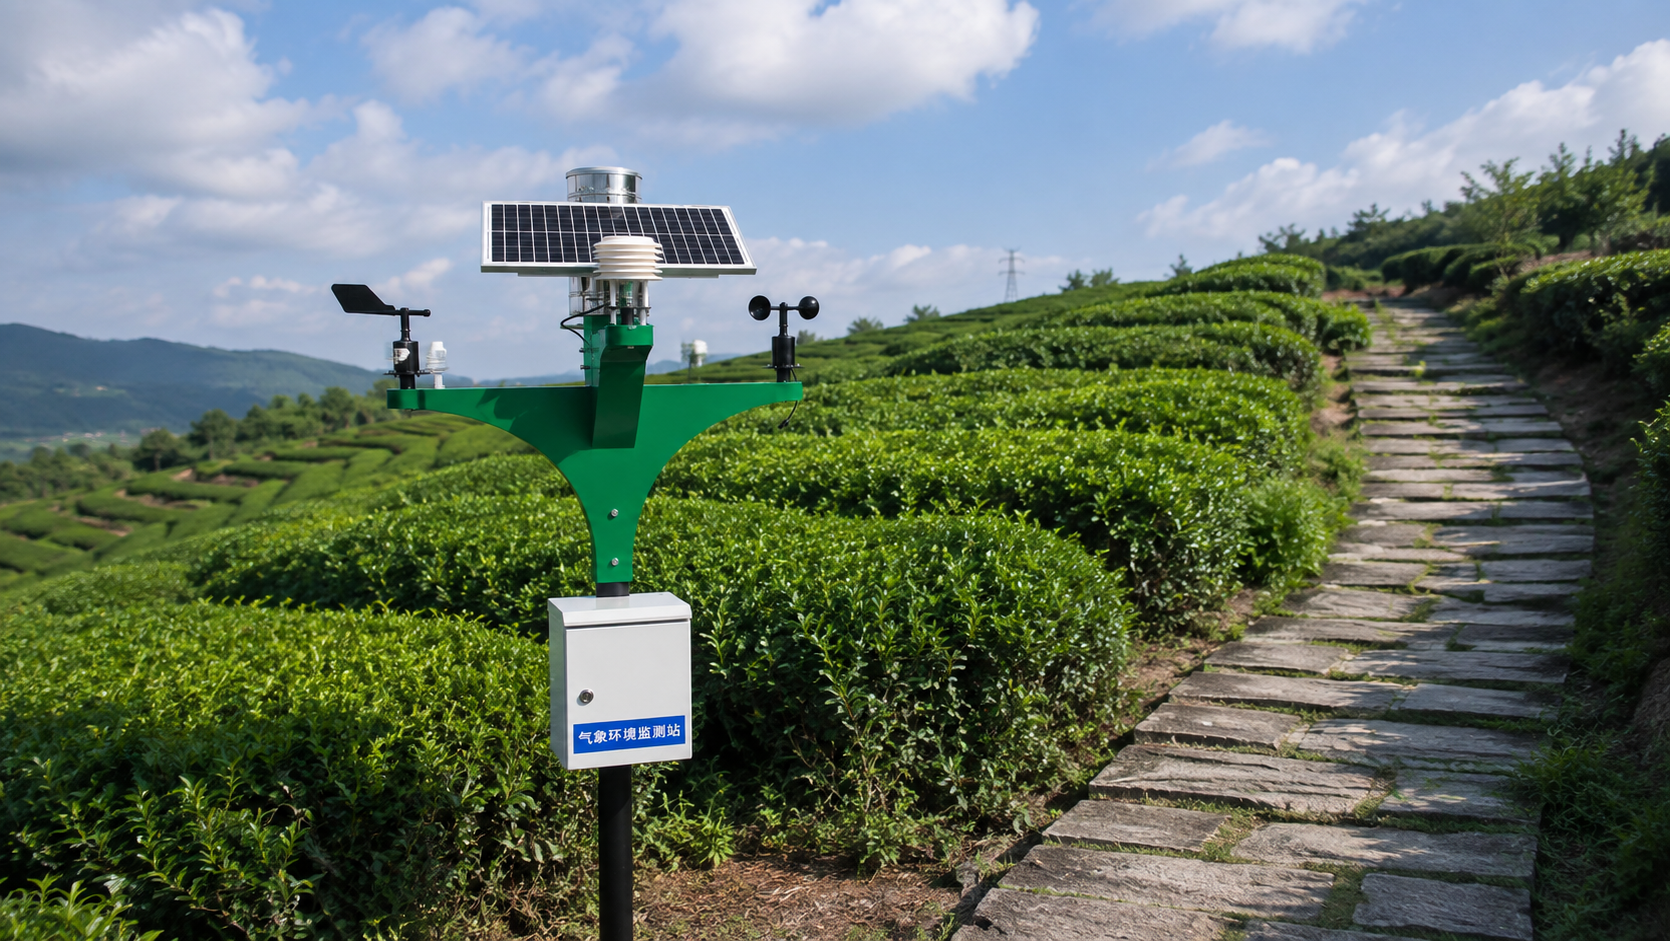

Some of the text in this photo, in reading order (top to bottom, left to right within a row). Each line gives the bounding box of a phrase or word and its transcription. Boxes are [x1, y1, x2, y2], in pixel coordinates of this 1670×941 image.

[578, 723, 681, 745] 气象环境监测站
